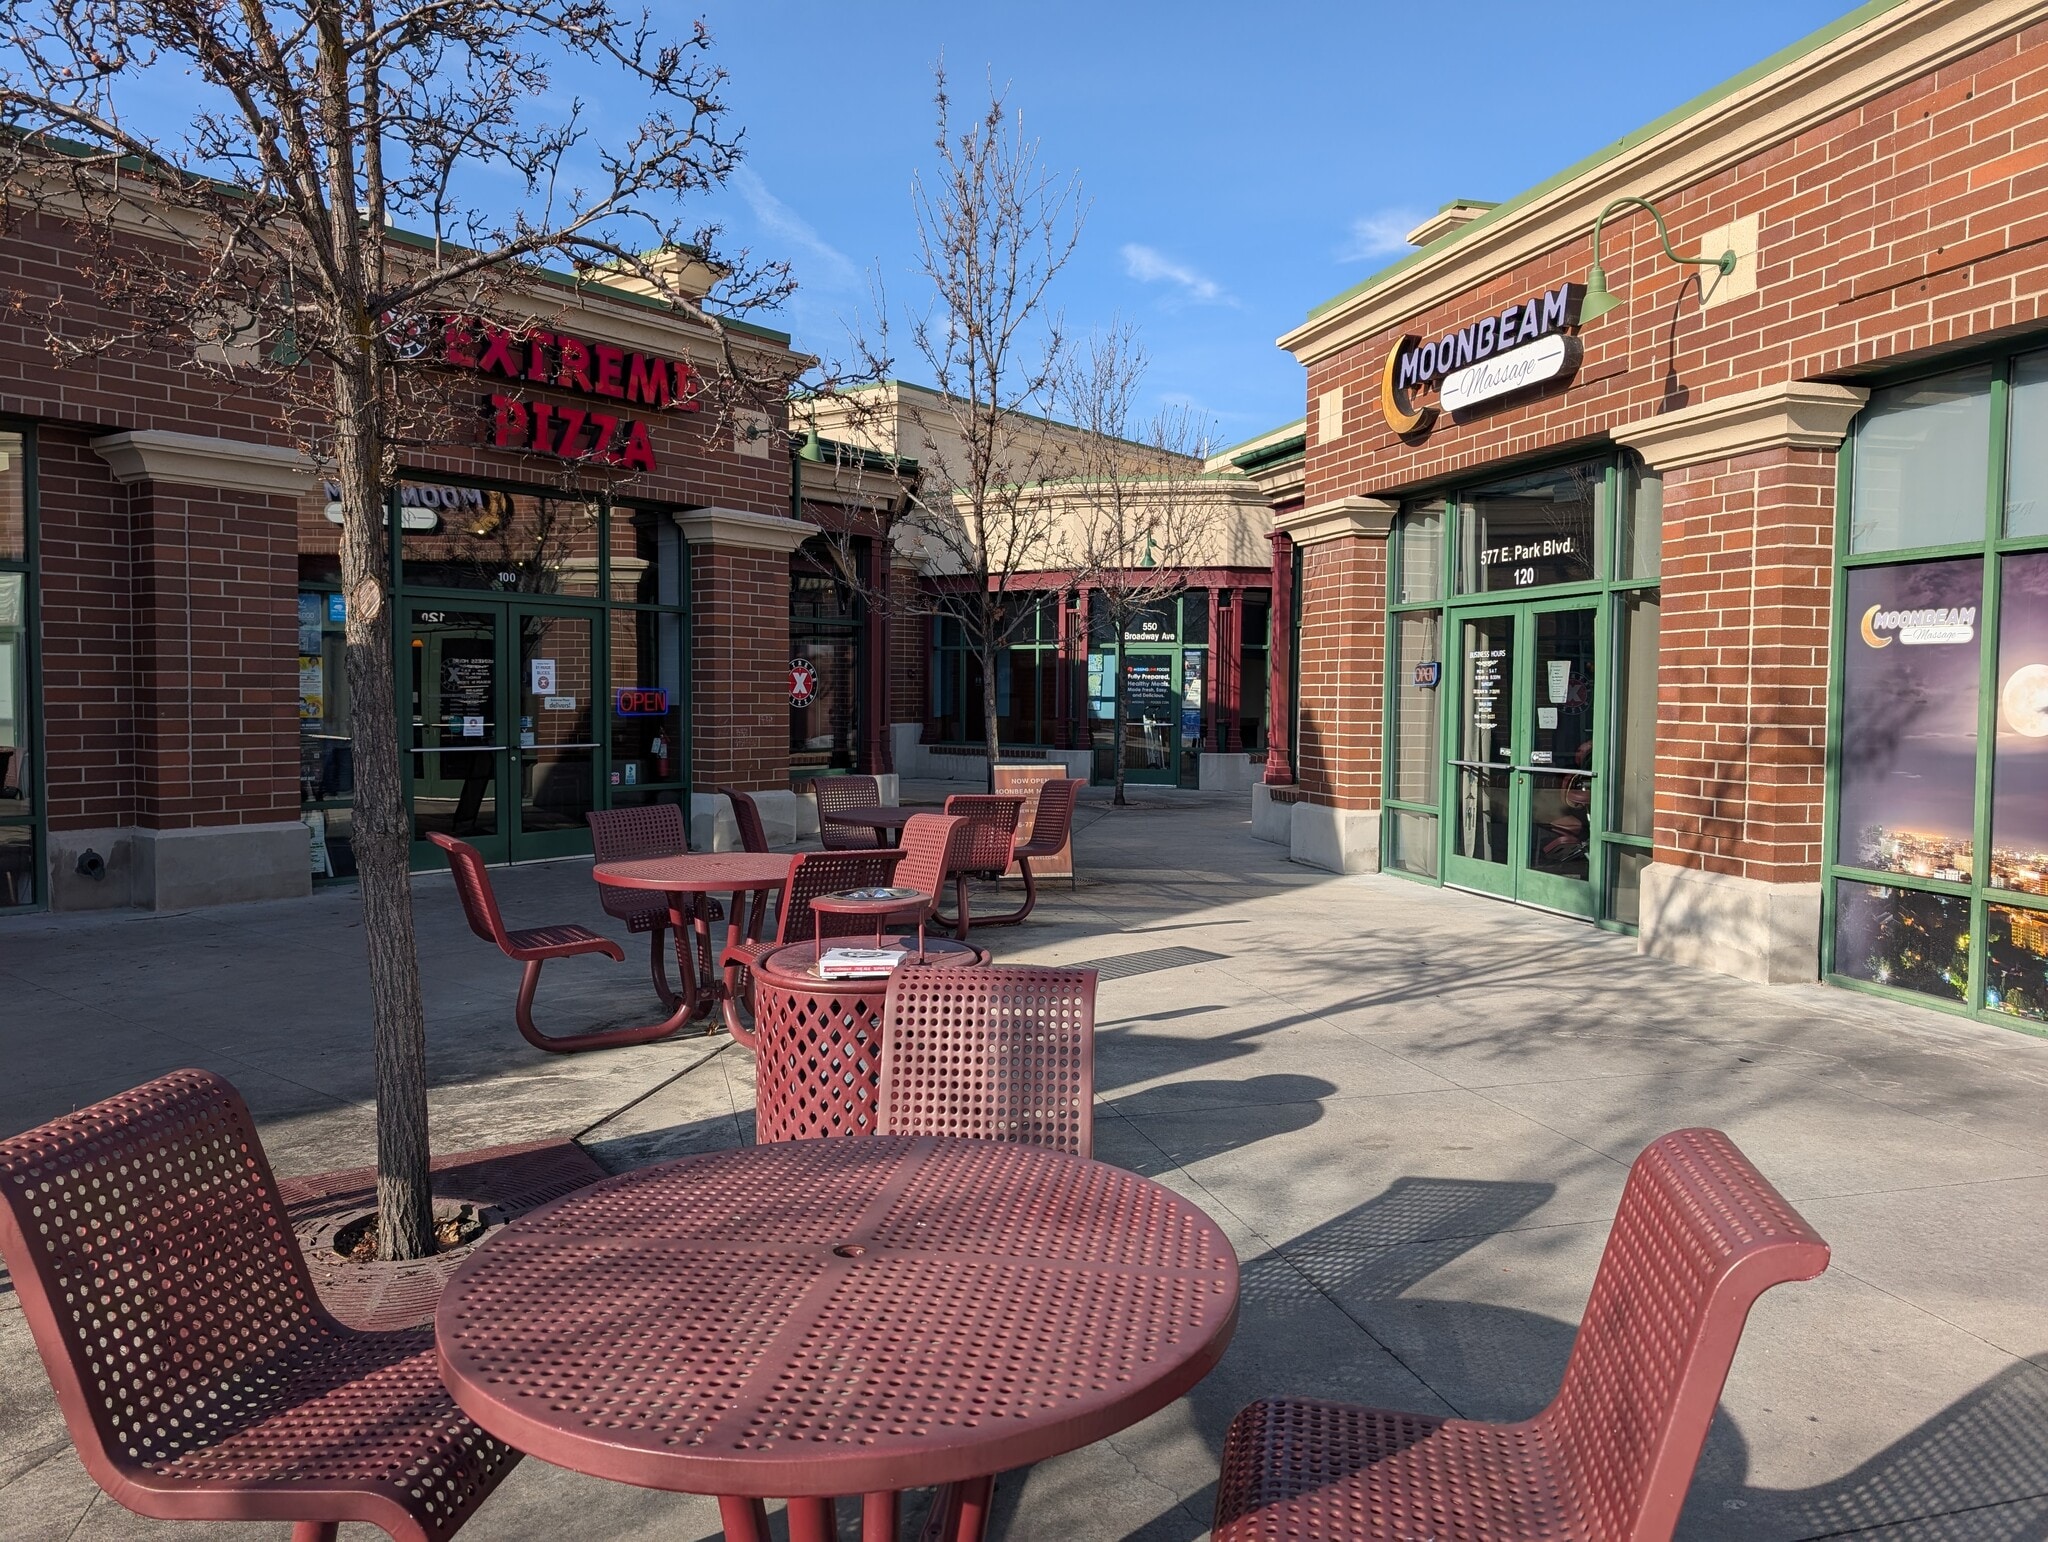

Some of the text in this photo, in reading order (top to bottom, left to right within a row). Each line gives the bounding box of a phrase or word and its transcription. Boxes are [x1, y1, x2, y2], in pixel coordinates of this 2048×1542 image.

[1398, 283, 1569, 390] MOONBEAM
[445, 311, 700, 413] EXTREME
[1460, 358, 1536, 398] Massage
[489, 394, 657, 472] PIZZA
[1480, 537, 1574, 566] 577 E. Park Blvd.
[499, 572, 516, 583] 100
[1513, 567, 1535, 585] 120
[1142, 622, 1158, 631] 550
[1874, 607, 1976, 629] MOONBEAM
[1124, 631, 1175, 642] Broadway Ave
[1912, 628, 1958, 641] Massage
[1469, 650, 1490, 659] BUSINESS
[792, 672, 808, 694] X
[1127, 680, 1150, 689] Healthy
[1415, 665, 1435, 686] OPEN
[620, 692, 666, 712] OPEN
